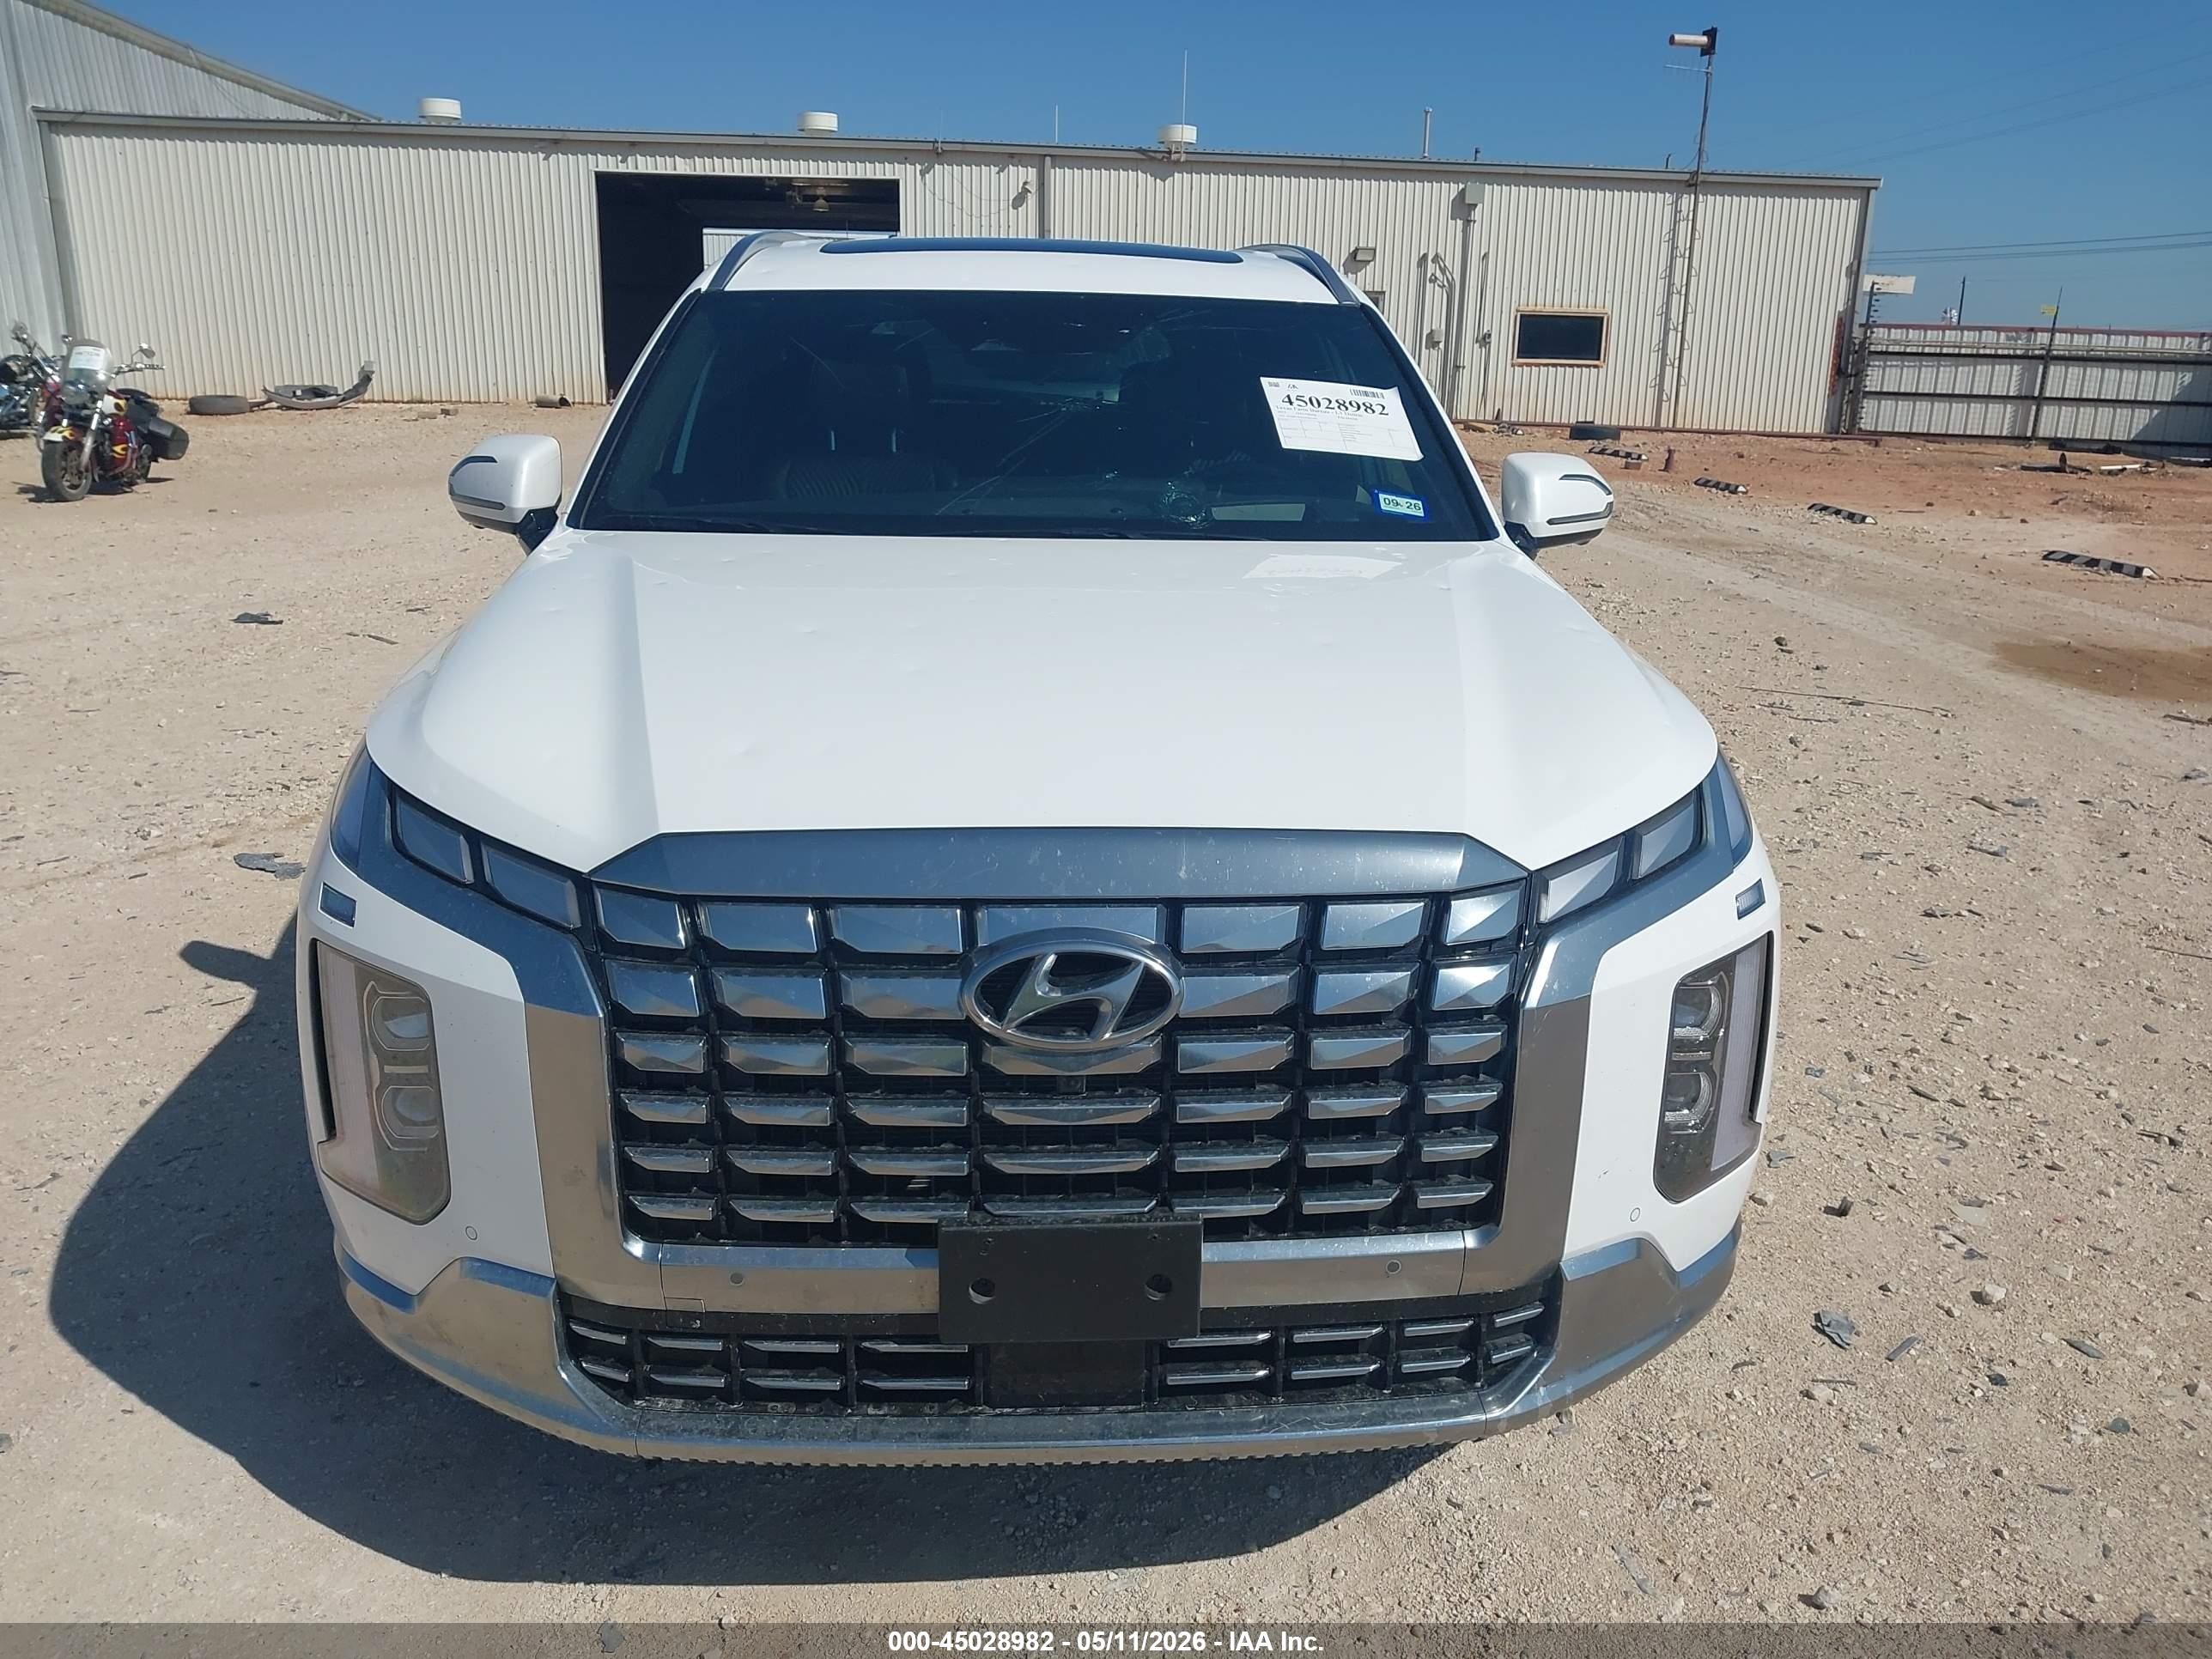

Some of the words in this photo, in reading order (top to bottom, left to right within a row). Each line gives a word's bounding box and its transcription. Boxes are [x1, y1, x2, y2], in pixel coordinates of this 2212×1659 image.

[1281, 393, 1389, 416] 45028982
[1382, 497, 1399, 507] 09
[1405, 501, 1422, 511] 26
